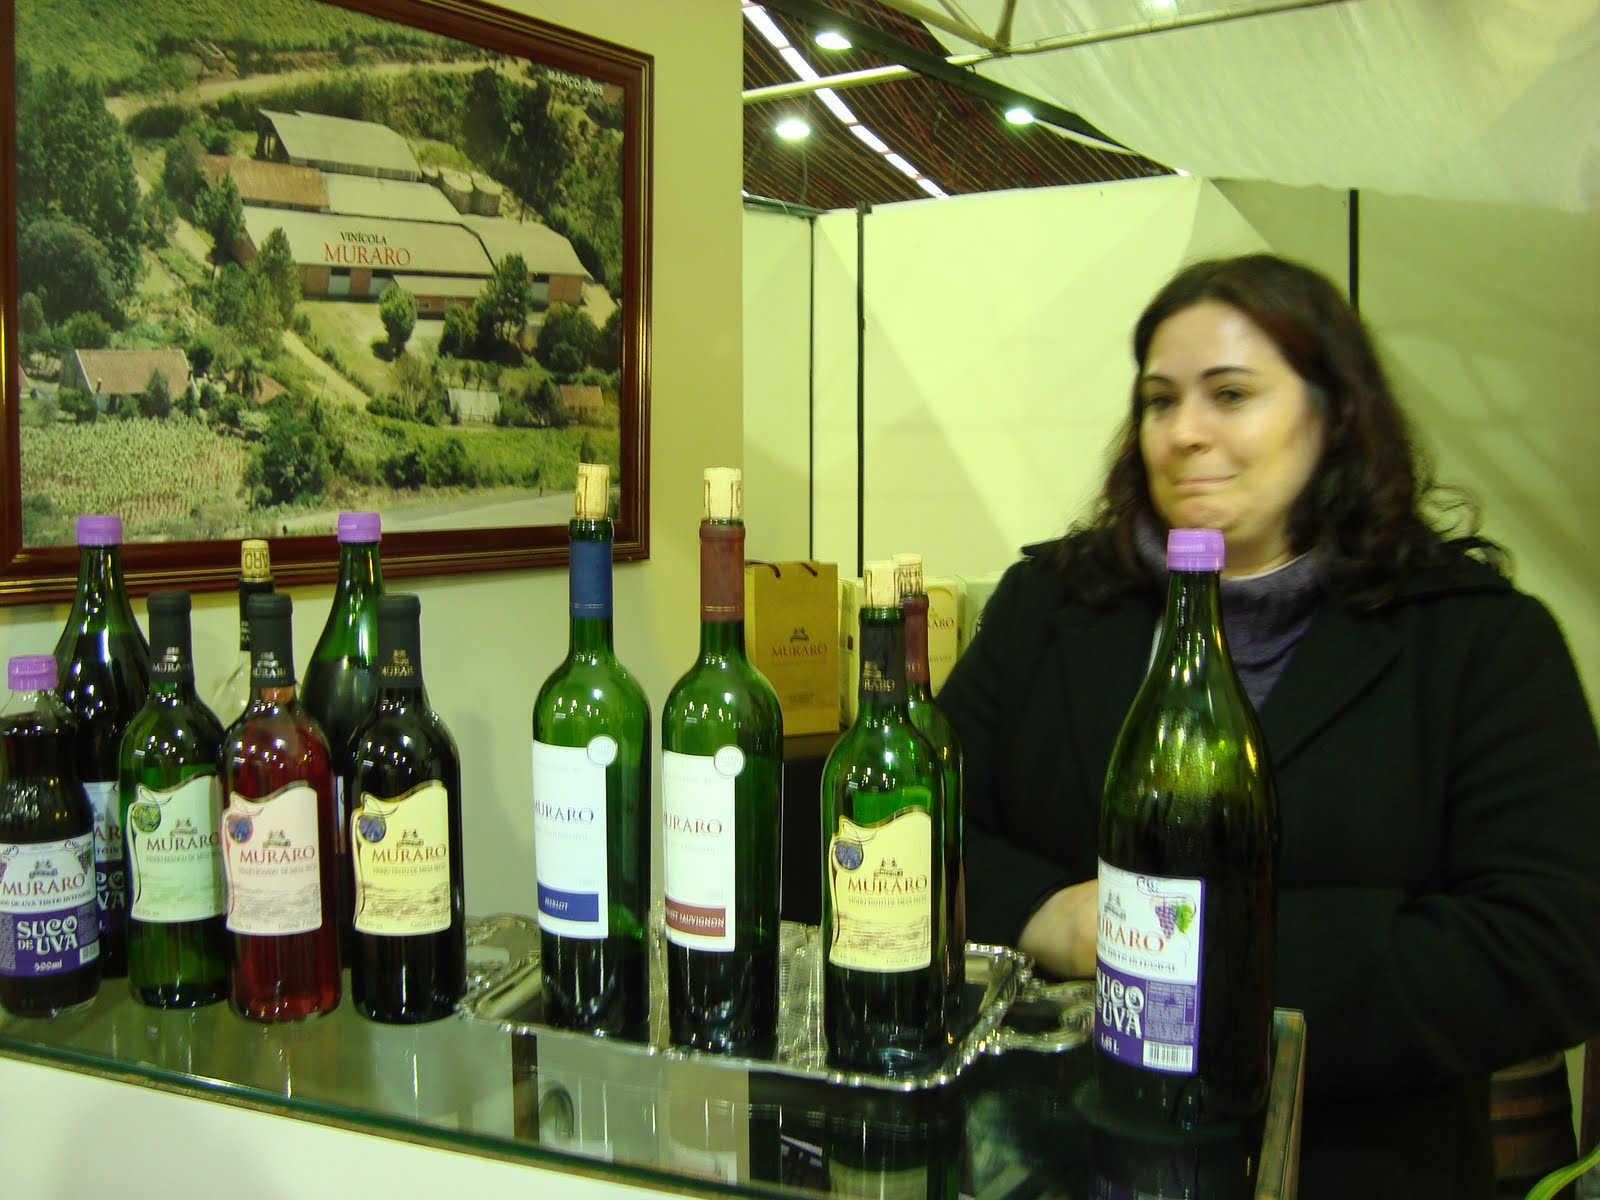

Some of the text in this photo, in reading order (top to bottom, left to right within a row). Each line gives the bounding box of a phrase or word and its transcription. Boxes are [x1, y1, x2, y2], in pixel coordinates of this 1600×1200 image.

[324, 242, 411, 266] MURARO
[771, 643, 828, 657] MURARO
[146, 831, 219, 851] MURARO
[239, 844, 316, 864] MURARO
[371, 843, 448, 863] MURARO
[3, 872, 86, 897] MURARO
[847, 874, 928, 896] MURARO
[17, 915, 78, 939] SUCO
[18, 939, 34, 950] DE
[36, 932, 79, 955] UVA
[1103, 1000, 1143, 1039] UVA
